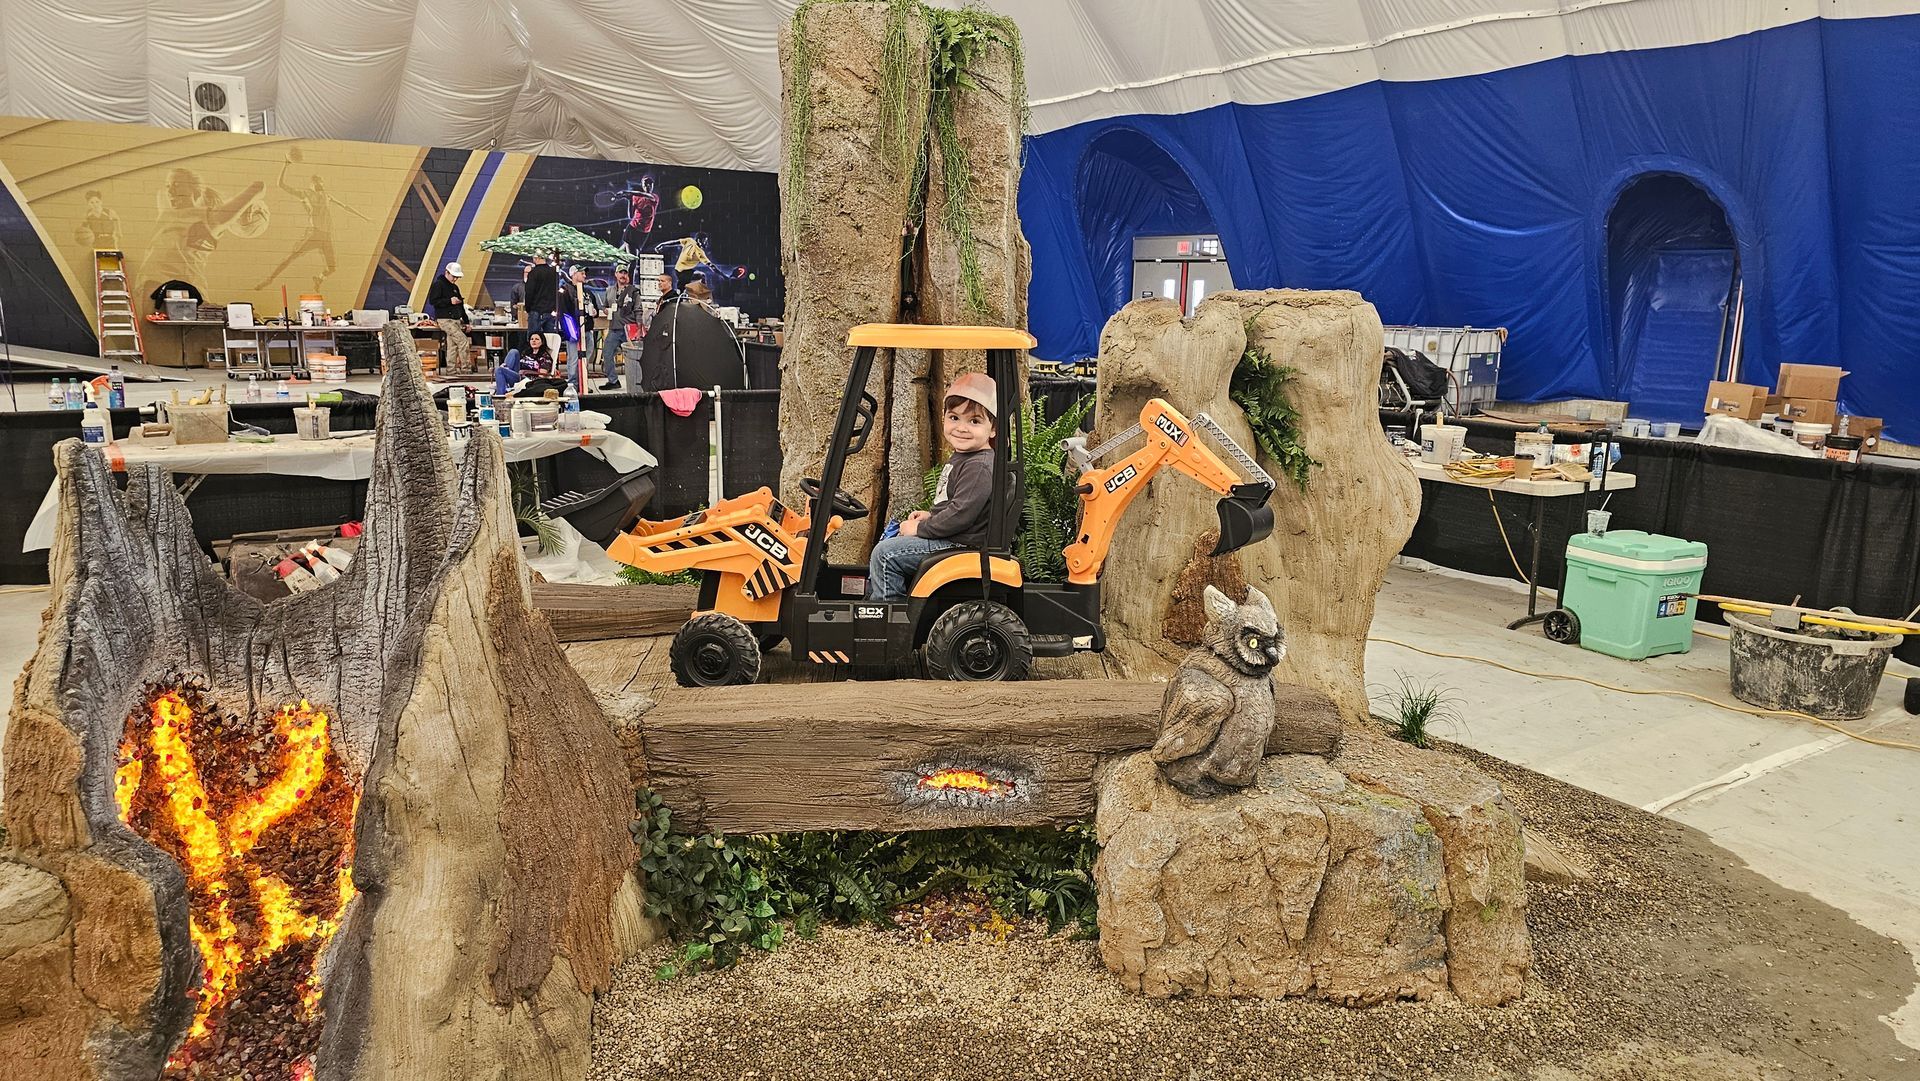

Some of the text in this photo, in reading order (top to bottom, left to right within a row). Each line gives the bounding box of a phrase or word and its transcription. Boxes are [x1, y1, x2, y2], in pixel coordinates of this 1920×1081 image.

[1107, 466, 1136, 492] JCB
[745, 524, 788, 560] JCB
[1663, 576, 1691, 587] IGLOO
[858, 606, 884, 615] 3CX
